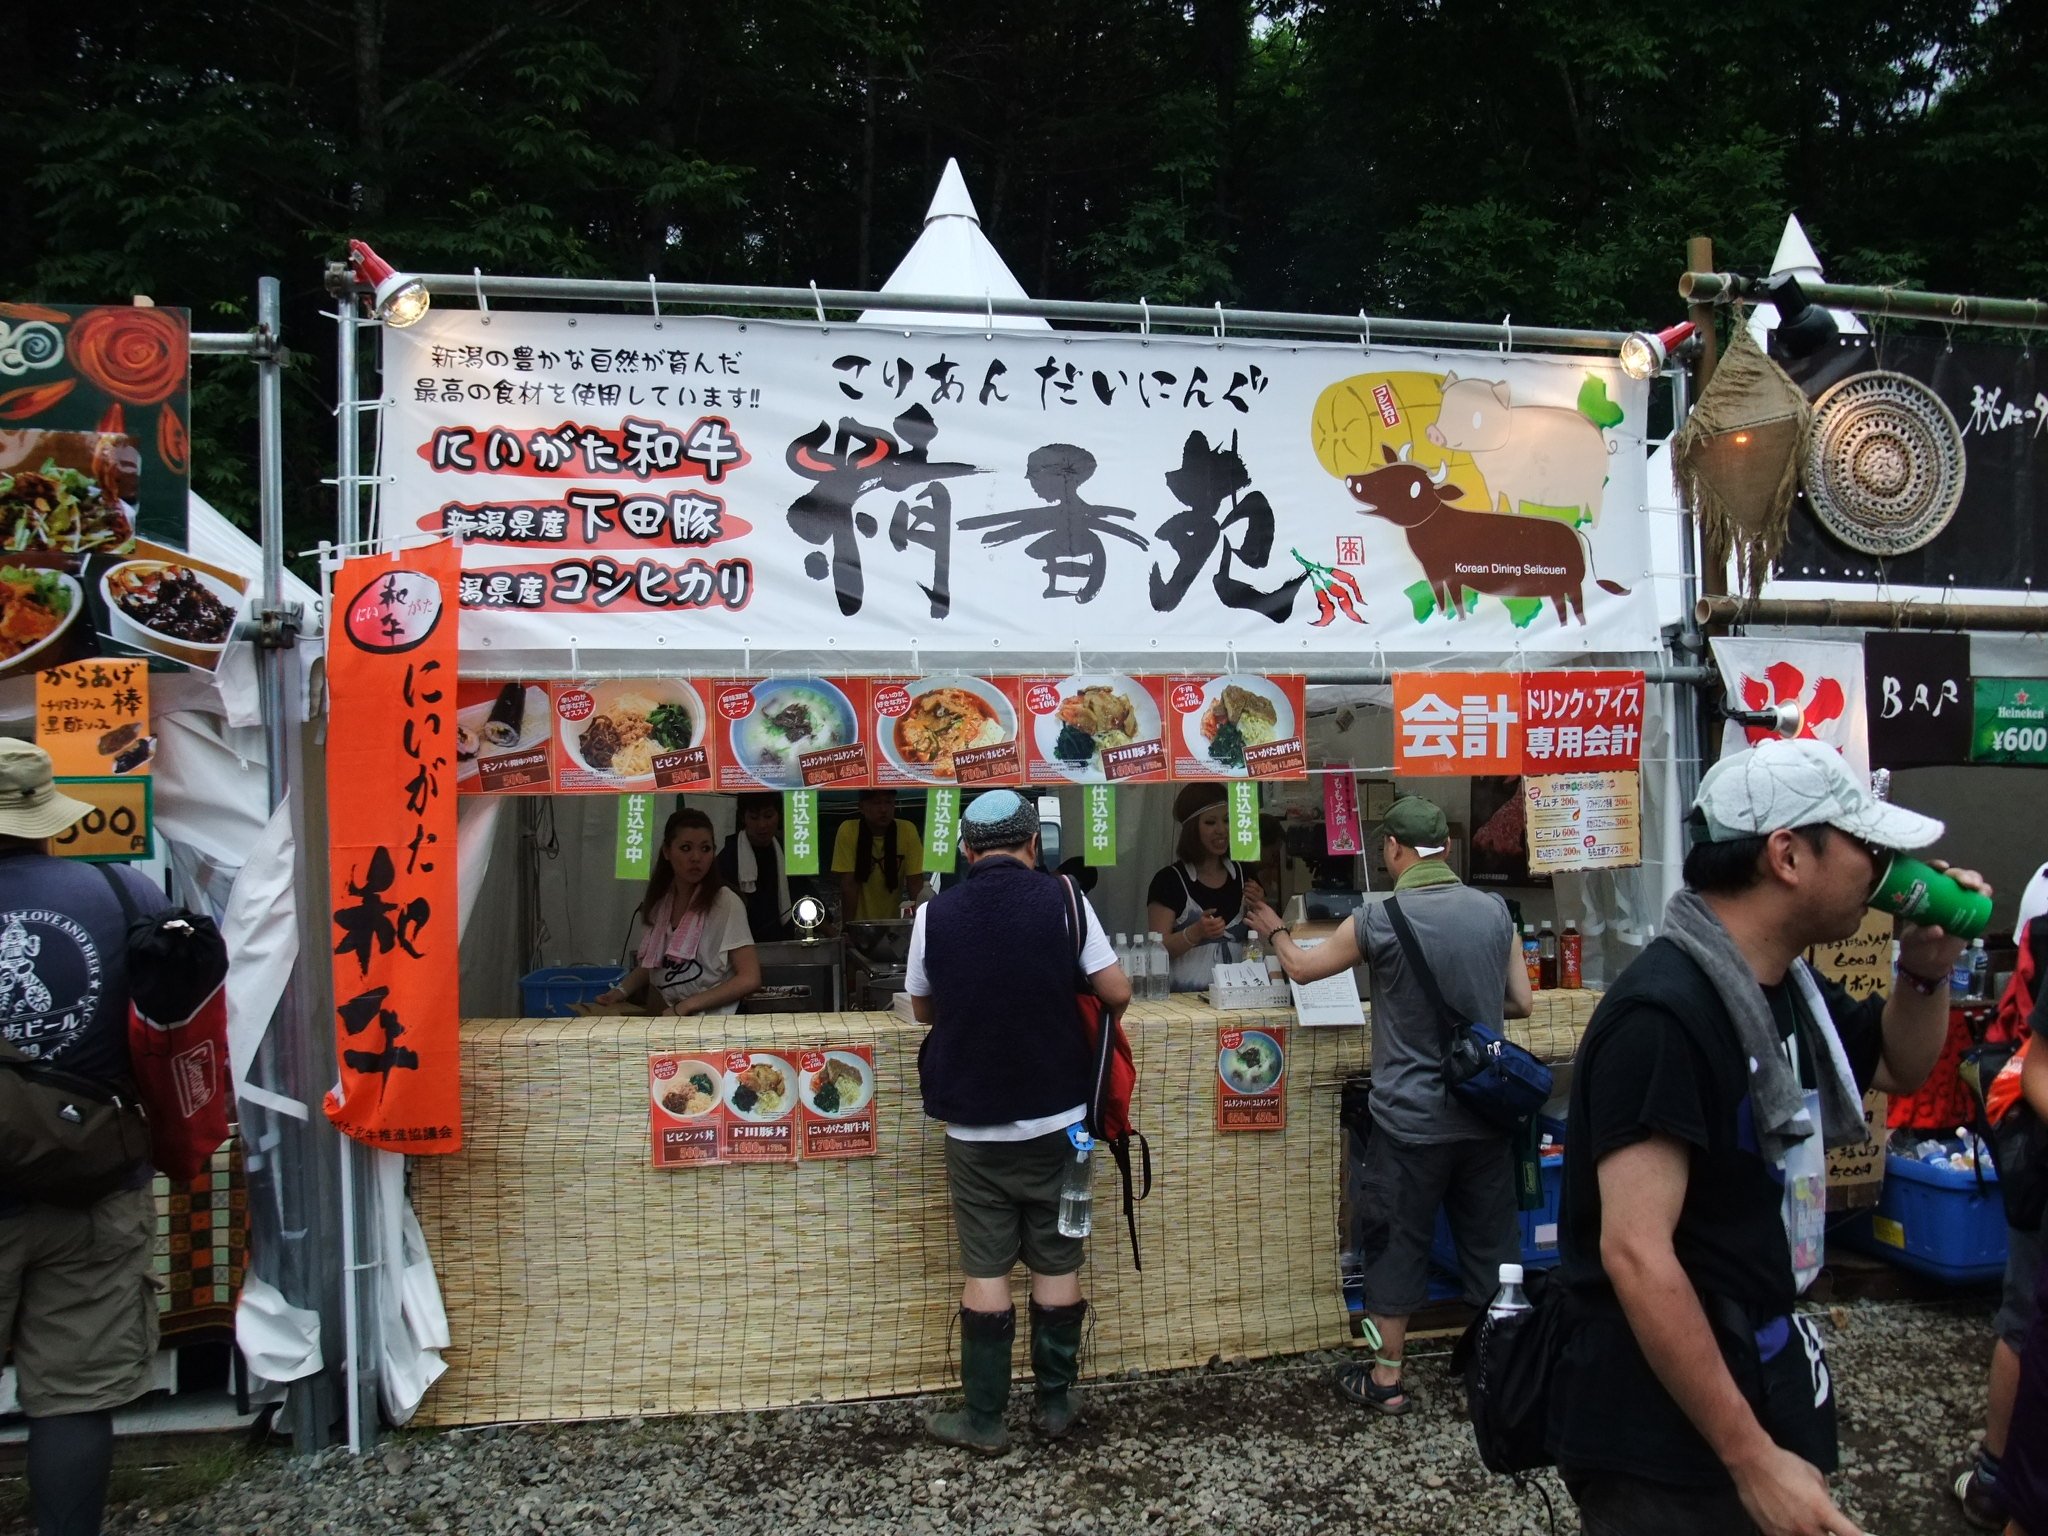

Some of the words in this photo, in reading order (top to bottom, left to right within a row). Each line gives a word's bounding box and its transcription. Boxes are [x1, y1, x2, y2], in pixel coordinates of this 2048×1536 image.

[431, 344, 742, 375] 新潟の豊かな自然が育んだ
[833, 354, 1009, 406] こりあん
[1034, 356, 1269, 413] だいにんぐ
[435, 420, 739, 477] にいがた和牛
[446, 508, 567, 540] 新潟県産
[571, 496, 720, 541] 下田豚
[554, 562, 747, 606] コシヒカリ
[1455, 562, 1488, 574] Korean
[1491, 563, 1521, 577] Dining
[1523, 563, 1567, 576] Seikouen
[44, 662, 141, 688] からあげ
[1881, 675, 1959, 719] BAR
[111, 687, 143, 717] 棒
[1526, 688, 1640, 720] ドリンク・アイス
[1998, 706, 2045, 719] Heineken
[1401, 693, 1518, 759] 会計
[1526, 724, 1639, 760] 専用会計
[1993, 727, 2048, 752] ¥600
[404, 661, 446, 875] にいがた
[656, 751, 705, 769] ビビンバ丼
[792, 790, 811, 859] 仕込み中
[932, 789, 953, 857] 仕込み中
[1092, 785, 1109, 851] 仕込み中
[1236, 781, 1252, 846] 仕込み中
[1534, 798, 1558, 809] キムチ
[626, 794, 646, 864] 仕込み中
[1535, 829, 1560, 840] ビール
[22, 911, 62, 926] LOVE
[60, 920, 88, 943] AND
[82, 943, 101, 975] BEER
[334, 846, 431, 1105] 和牛
[666, 1129, 715, 1142] ビビンバ丼
